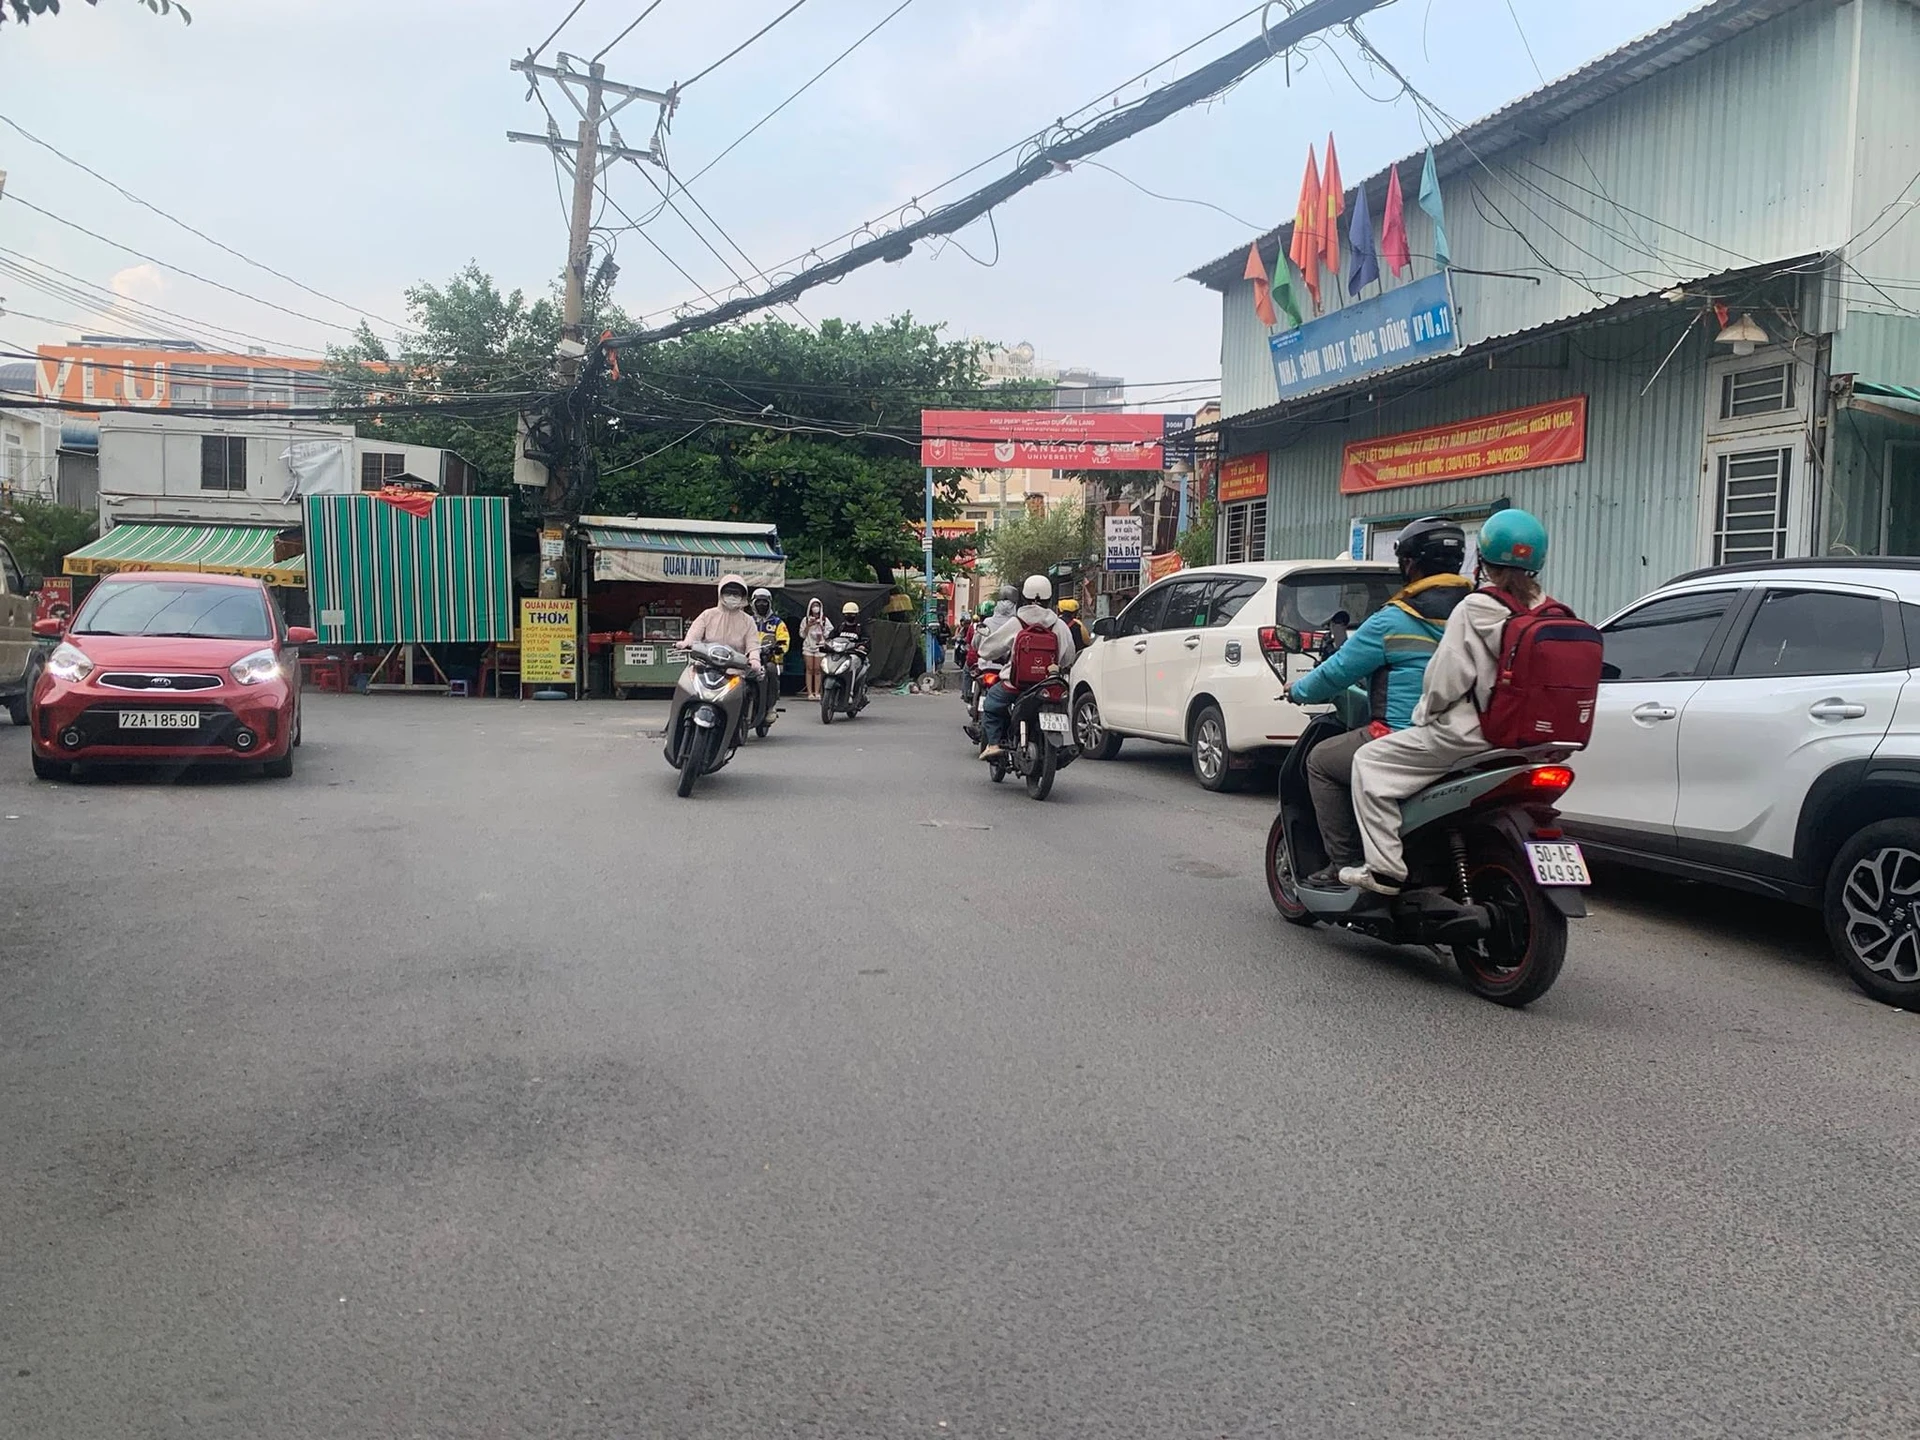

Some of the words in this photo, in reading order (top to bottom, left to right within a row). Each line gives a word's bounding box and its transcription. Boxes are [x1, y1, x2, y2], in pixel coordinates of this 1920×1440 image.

[36, 355, 165, 407] VLU
[1440, 435, 1449, 450] 51
[1091, 456, 1111, 464] VLSC
[1108, 543, 1123, 556] NHÀ
[1125, 541, 1140, 556] ĐẤT
[528, 611, 569, 624] THƠM
[121, 713, 197, 727] 72A-185.90
[1534, 845, 1576, 863] 50-AE
[1537, 864, 1585, 883] 849.93
